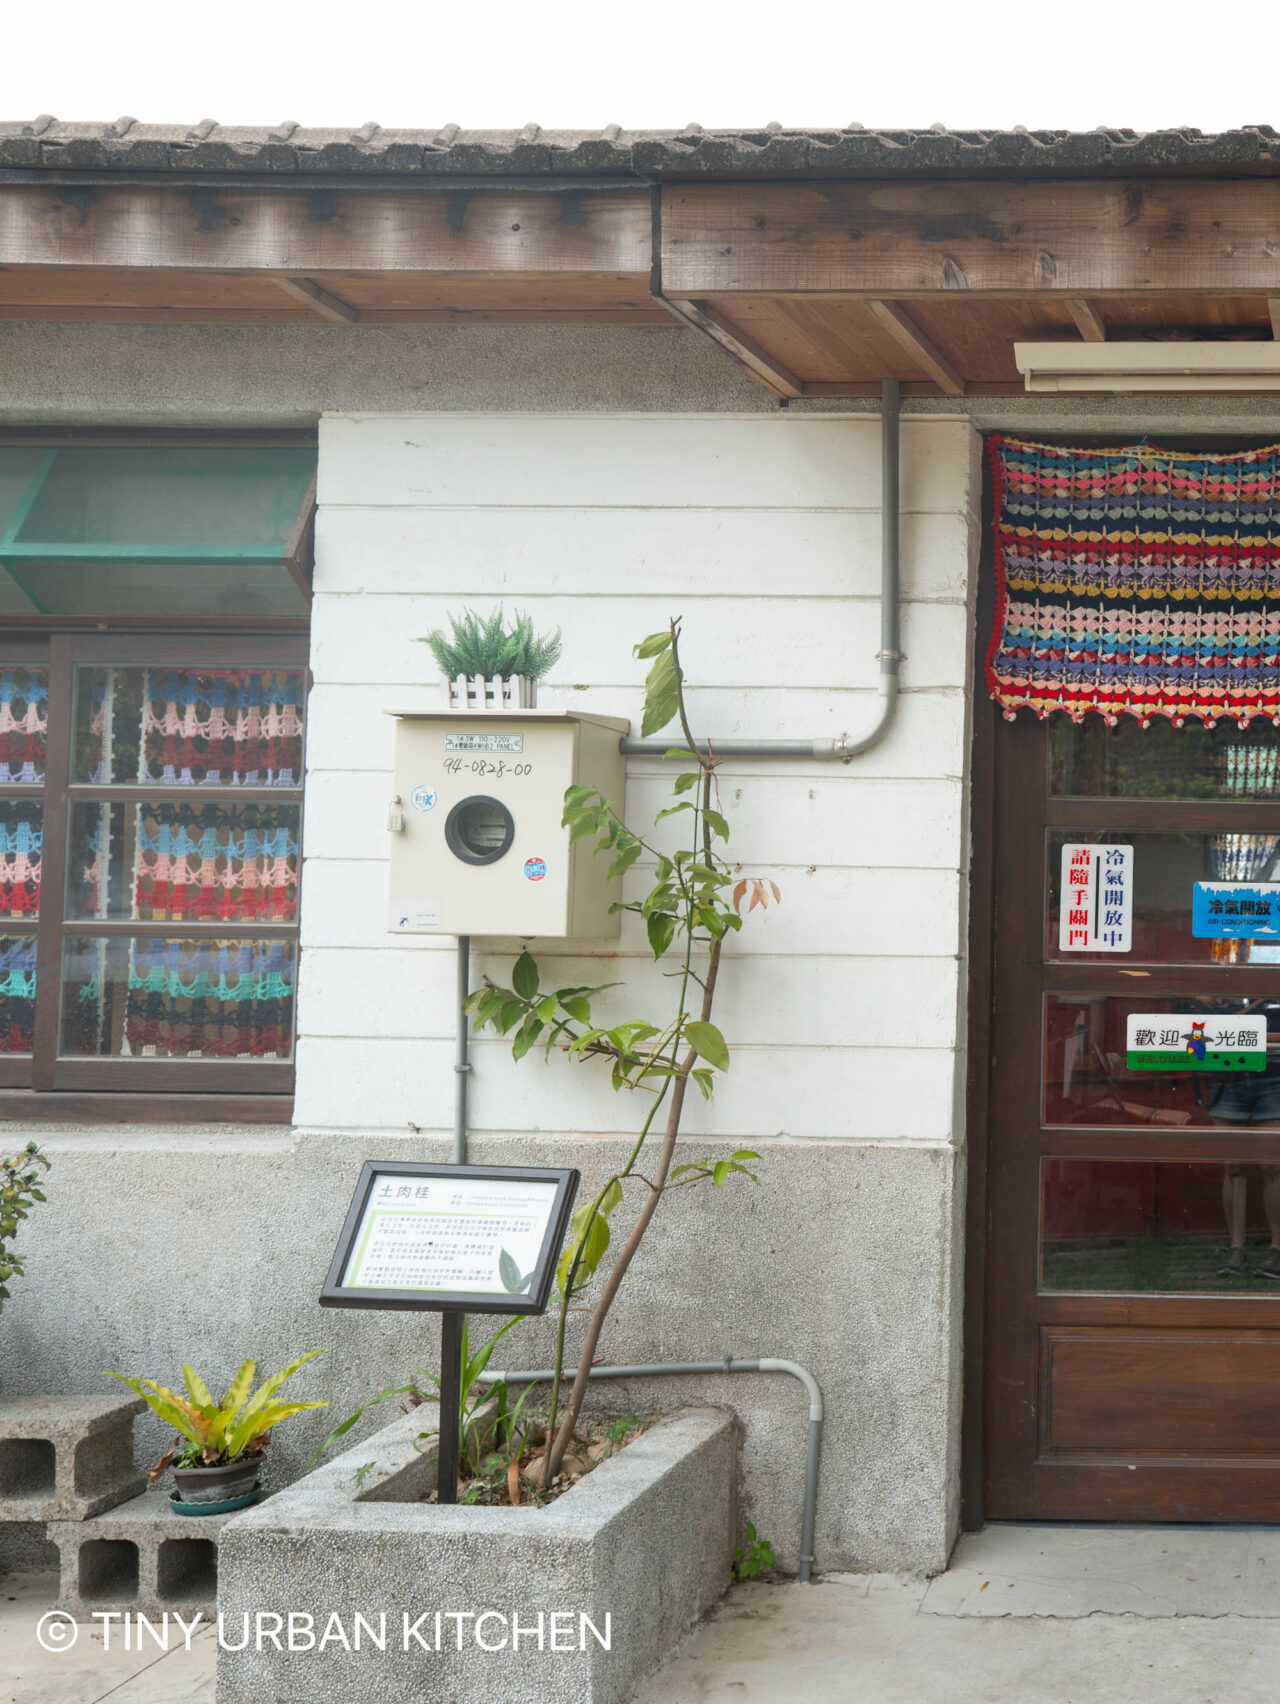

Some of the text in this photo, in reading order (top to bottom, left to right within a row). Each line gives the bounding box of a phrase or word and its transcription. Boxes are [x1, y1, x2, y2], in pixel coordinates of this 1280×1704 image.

[443, 757, 532, 778] 94-0828-00
[1069, 849, 1091, 946] 請隨手關門
[1103, 849, 1125, 947] 冷氣開放中
[1208, 899, 1271, 916] 冷氣開放
[1221, 918, 1271, 926] CONDITIONING
[378, 1183, 432, 1199] 土肉桂
